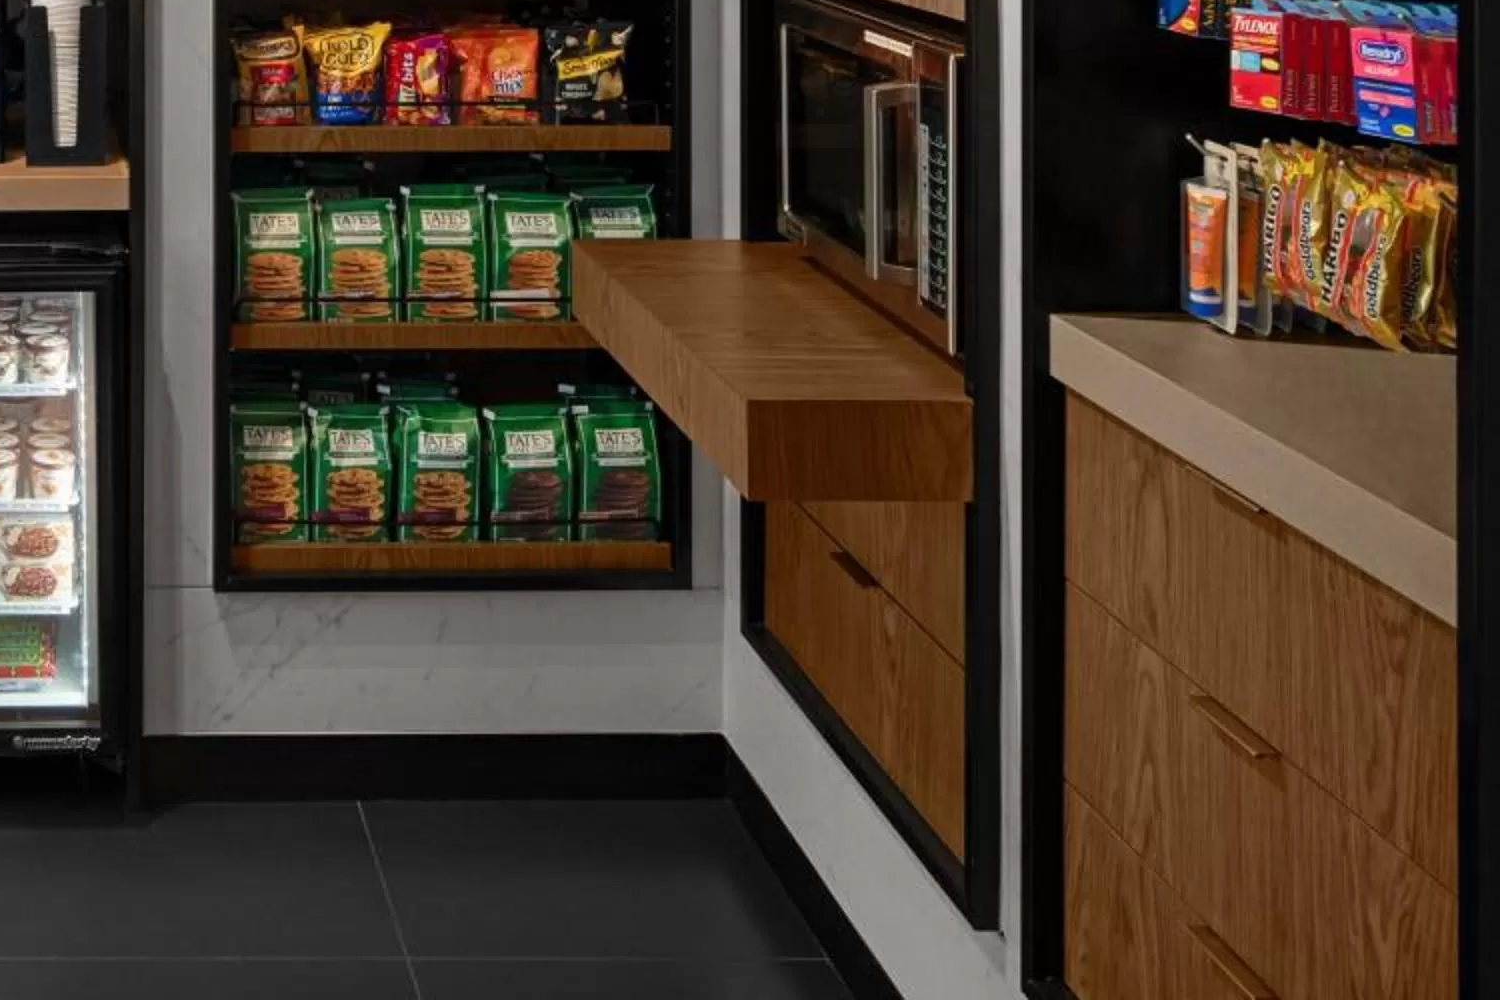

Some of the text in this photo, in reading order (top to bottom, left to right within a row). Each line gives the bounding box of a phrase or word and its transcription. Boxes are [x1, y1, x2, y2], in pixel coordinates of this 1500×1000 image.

[1234, 14, 1279, 35] TYLENOL
[1264, 184, 1282, 273] HARIBO
[1321, 211, 1348, 303] HARIBO
[1401, 246, 1422, 322] oldbears
